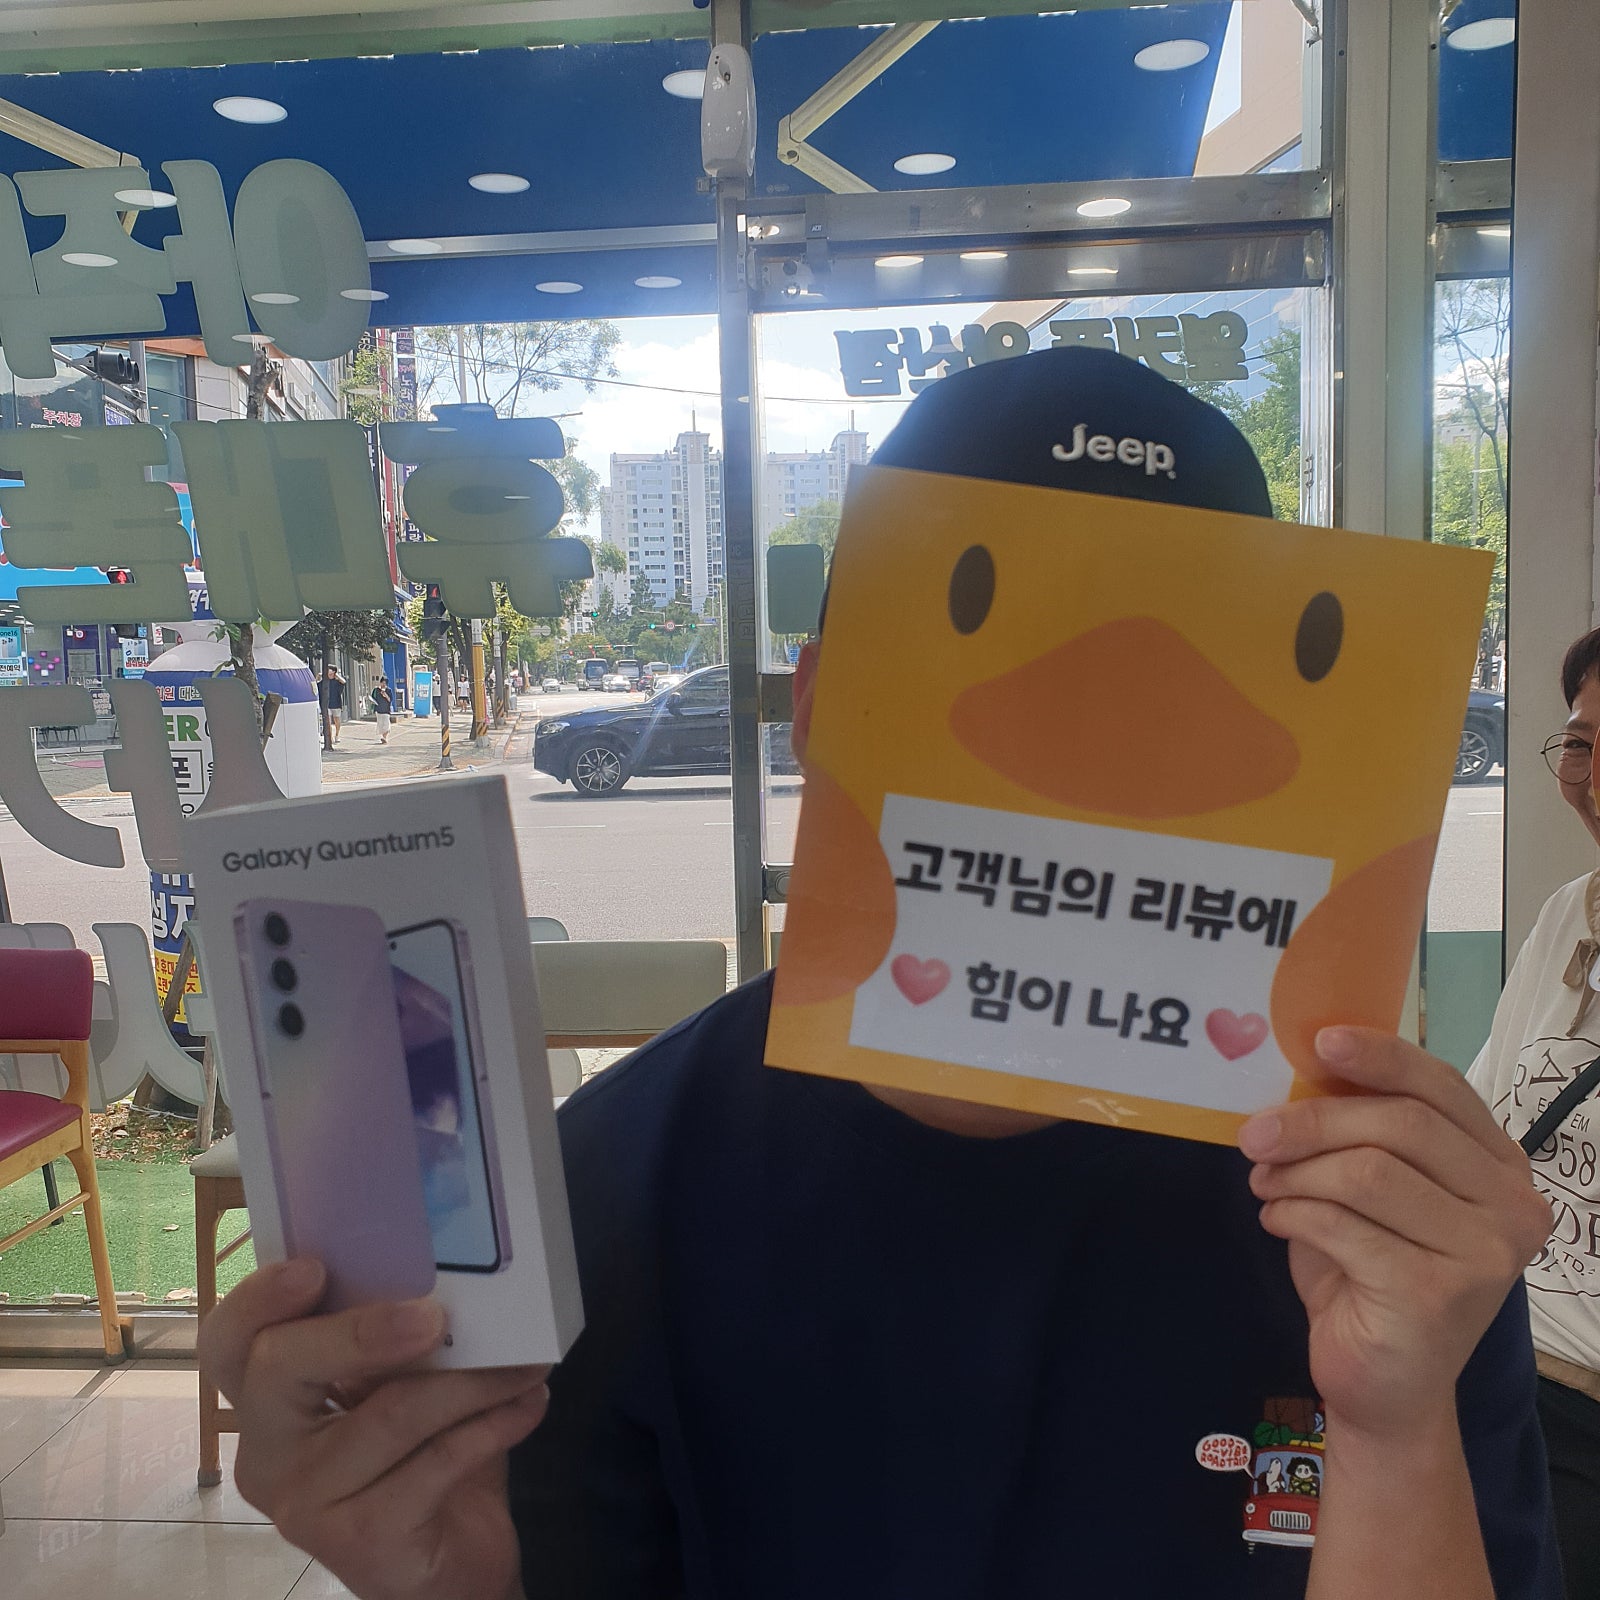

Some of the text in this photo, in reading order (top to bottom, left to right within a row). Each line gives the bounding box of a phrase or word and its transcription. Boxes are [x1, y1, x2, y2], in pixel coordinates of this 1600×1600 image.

[43, 409, 82, 427] 주차장
[1051, 423, 1176, 477] Jeep
[222, 826, 455, 873] Galaxy Quantum5
[895, 841, 1298, 949] 고객님의 리뷰에
[966, 961, 1191, 1048] 힘이 나요
